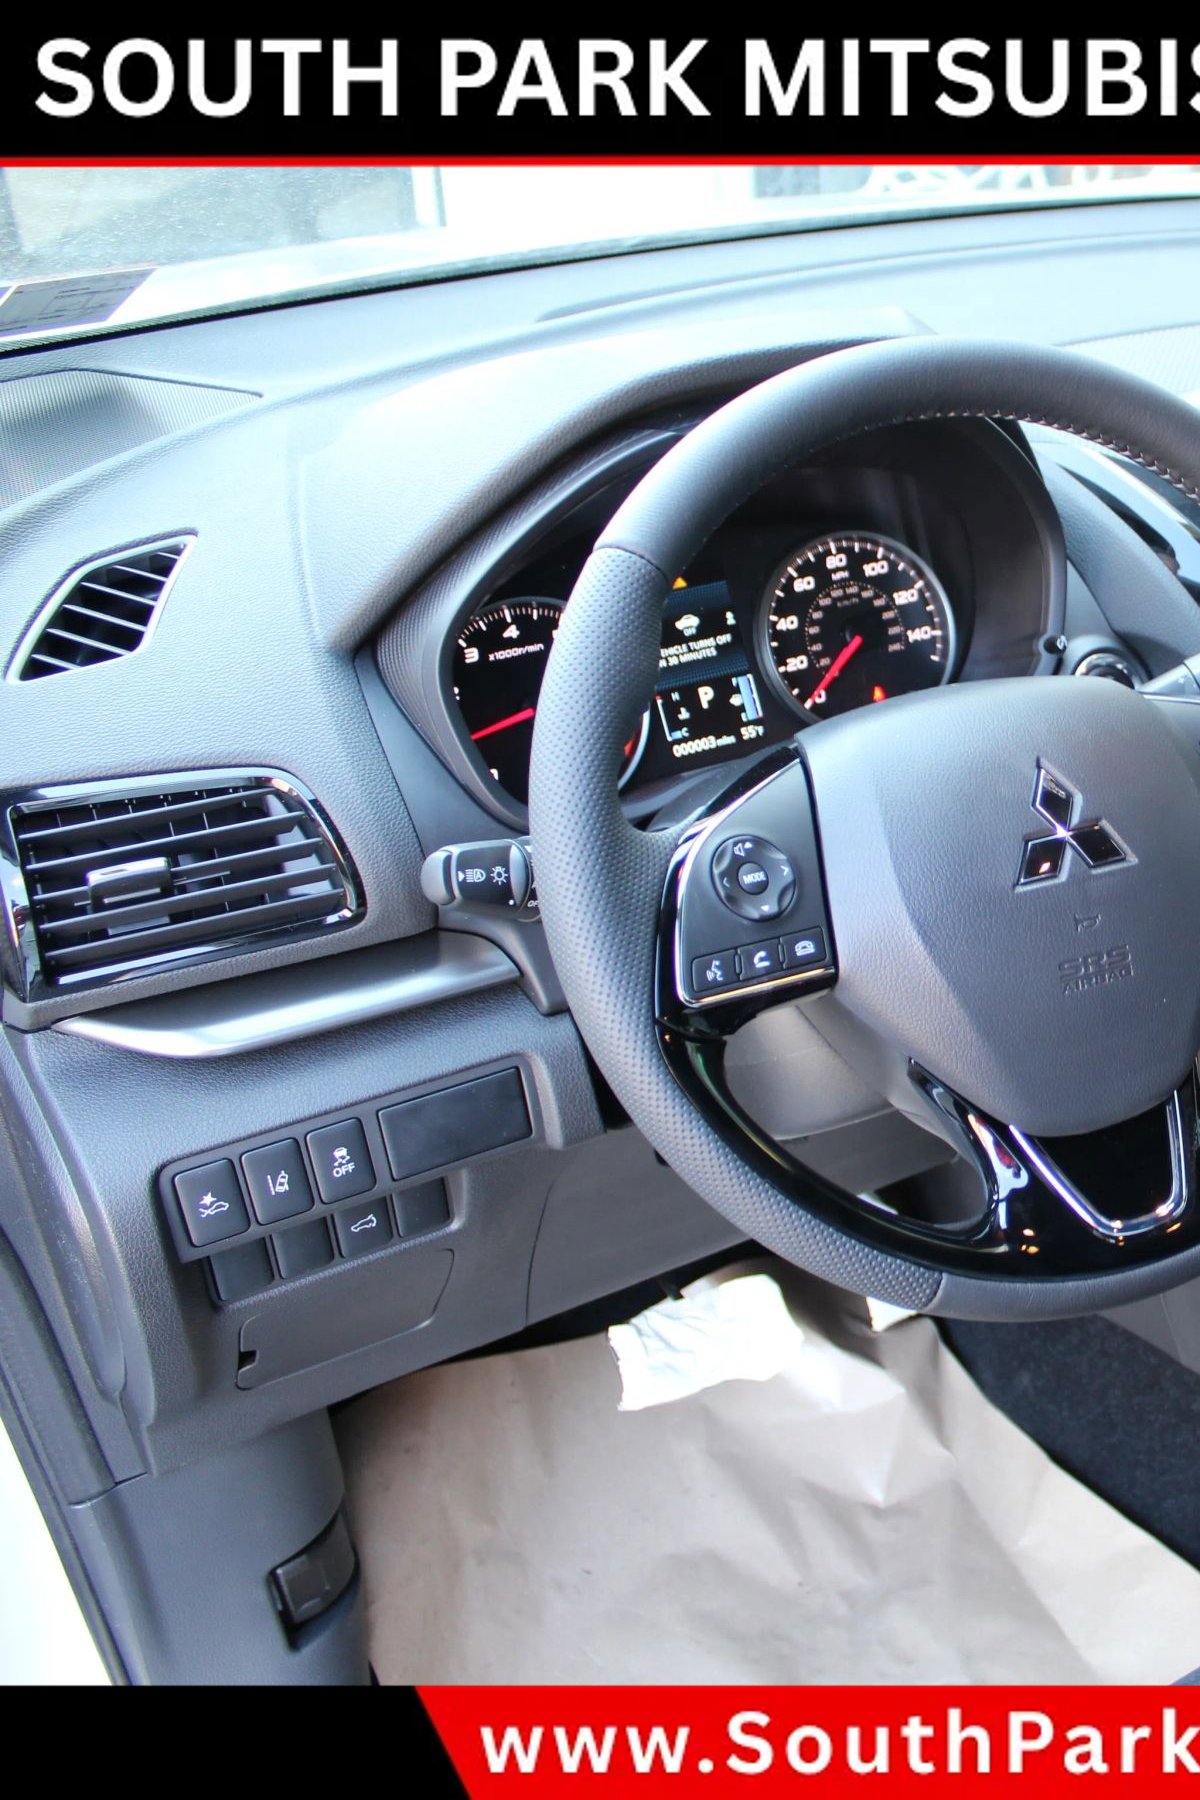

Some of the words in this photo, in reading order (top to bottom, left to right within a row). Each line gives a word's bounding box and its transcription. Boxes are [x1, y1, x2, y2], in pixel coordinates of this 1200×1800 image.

[826, 553, 848, 569] 80
[863, 560, 888, 577] 100
[793, 576, 815, 592] 60
[831, 571, 849, 581] MPH
[893, 590, 918, 605] 120
[776, 615, 798, 631] 40
[502, 624, 520, 639] 4
[907, 626, 931, 642] 140
[488, 643, 544, 662] x1000r/min
[660, 643, 689, 658] EHICLE
[688, 637, 717, 650] TURNS
[716, 633, 733, 645] OFF
[464, 647, 479, 664] 3
[667, 655, 680, 666] 30
[679, 647, 718, 663] MINUTES
[786, 656, 808, 672] 20
[697, 686, 715, 710] P
[672, 735, 717, 758] 000003
[742, 871, 766, 885] MODE
[1058, 945, 1132, 979] SRS
[332, 1162, 356, 1178] OFF
